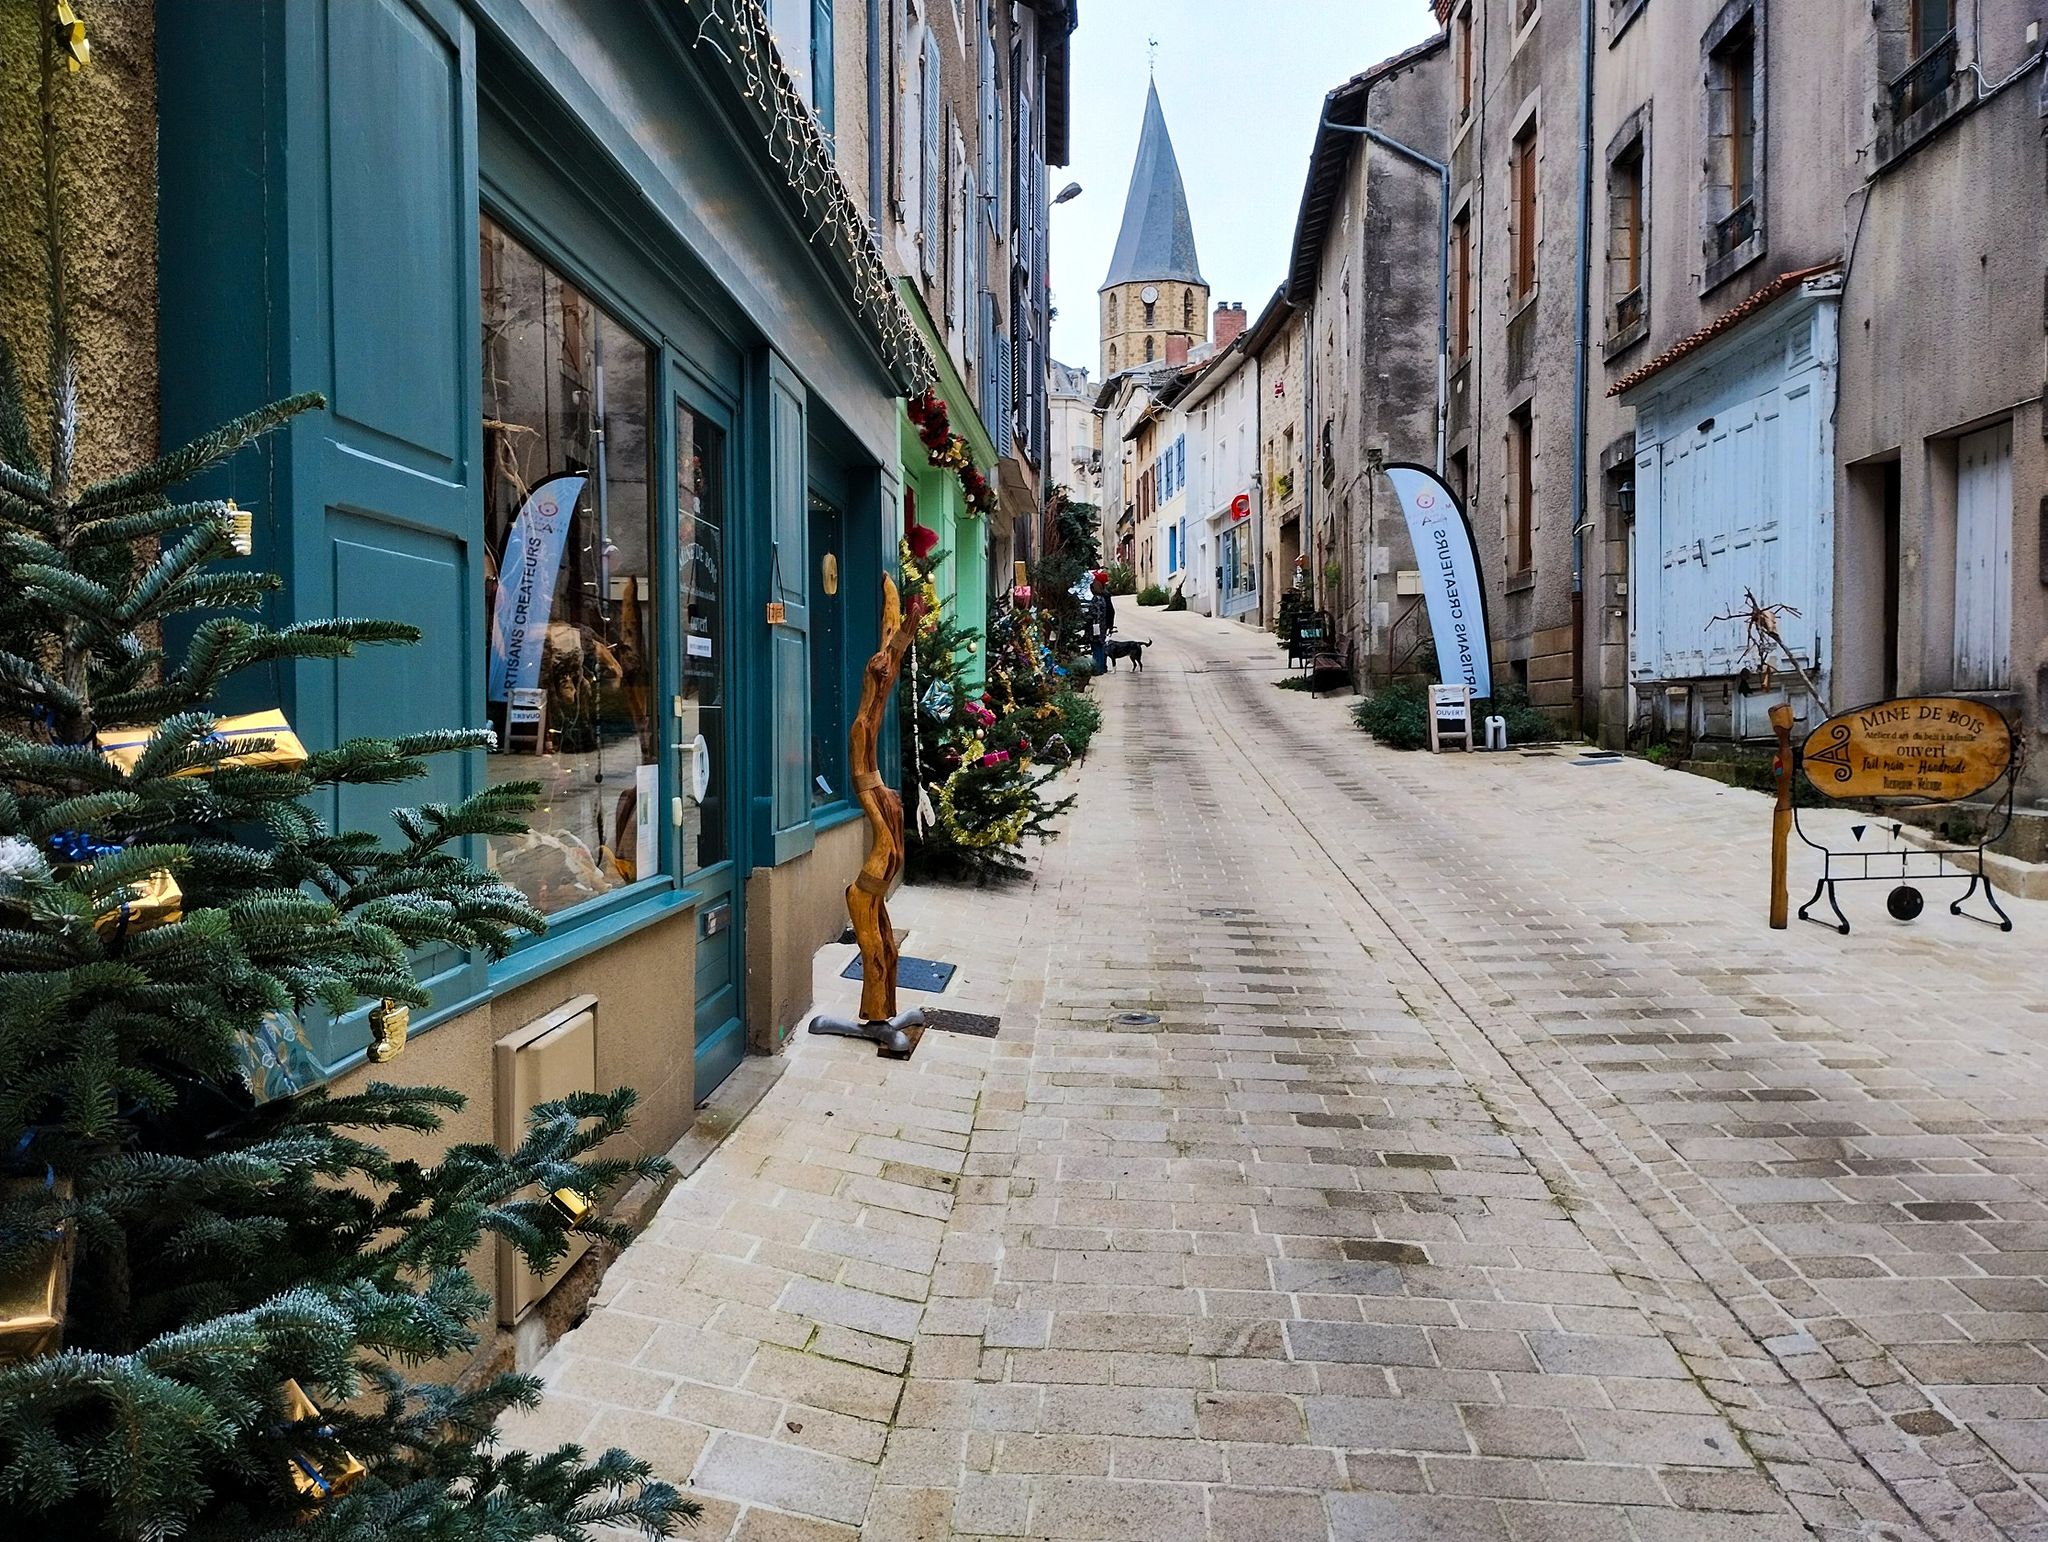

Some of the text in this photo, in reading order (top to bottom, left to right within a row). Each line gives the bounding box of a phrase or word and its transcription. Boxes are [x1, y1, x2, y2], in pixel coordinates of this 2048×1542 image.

[515, 537, 541, 625] CREATEURS
[1436, 709, 1464, 717] OUVERT
[1860, 706, 1985, 734] MINE DE BOIS
[1896, 744, 1946, 758] ouvert
